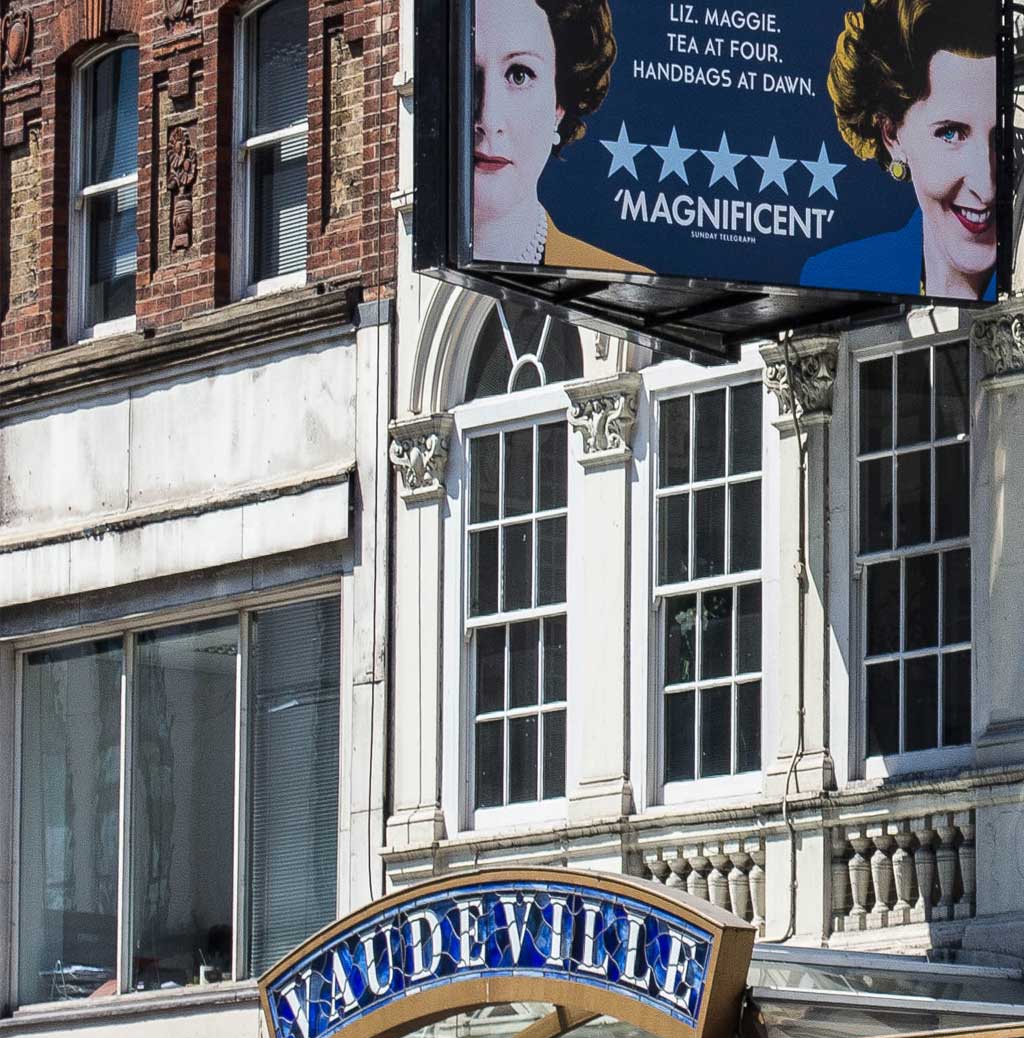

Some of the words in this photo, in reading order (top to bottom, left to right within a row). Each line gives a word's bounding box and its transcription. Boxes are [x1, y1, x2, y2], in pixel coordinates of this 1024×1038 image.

[669, 3, 699, 25] LIZ.
[703, 7, 782, 33] MAGGIE.
[667, 33, 699, 55] TEA
[704, 38, 725, 57] AT
[730, 40, 784, 64] FOUR.
[633, 60, 732, 88] HANDBAGS
[737, 72, 757, 91] AT
[763, 73, 816, 97] DAWN.
[690, 231, 718, 241] SUNDAY
[718, 234, 756, 245] TELEGRAPH
